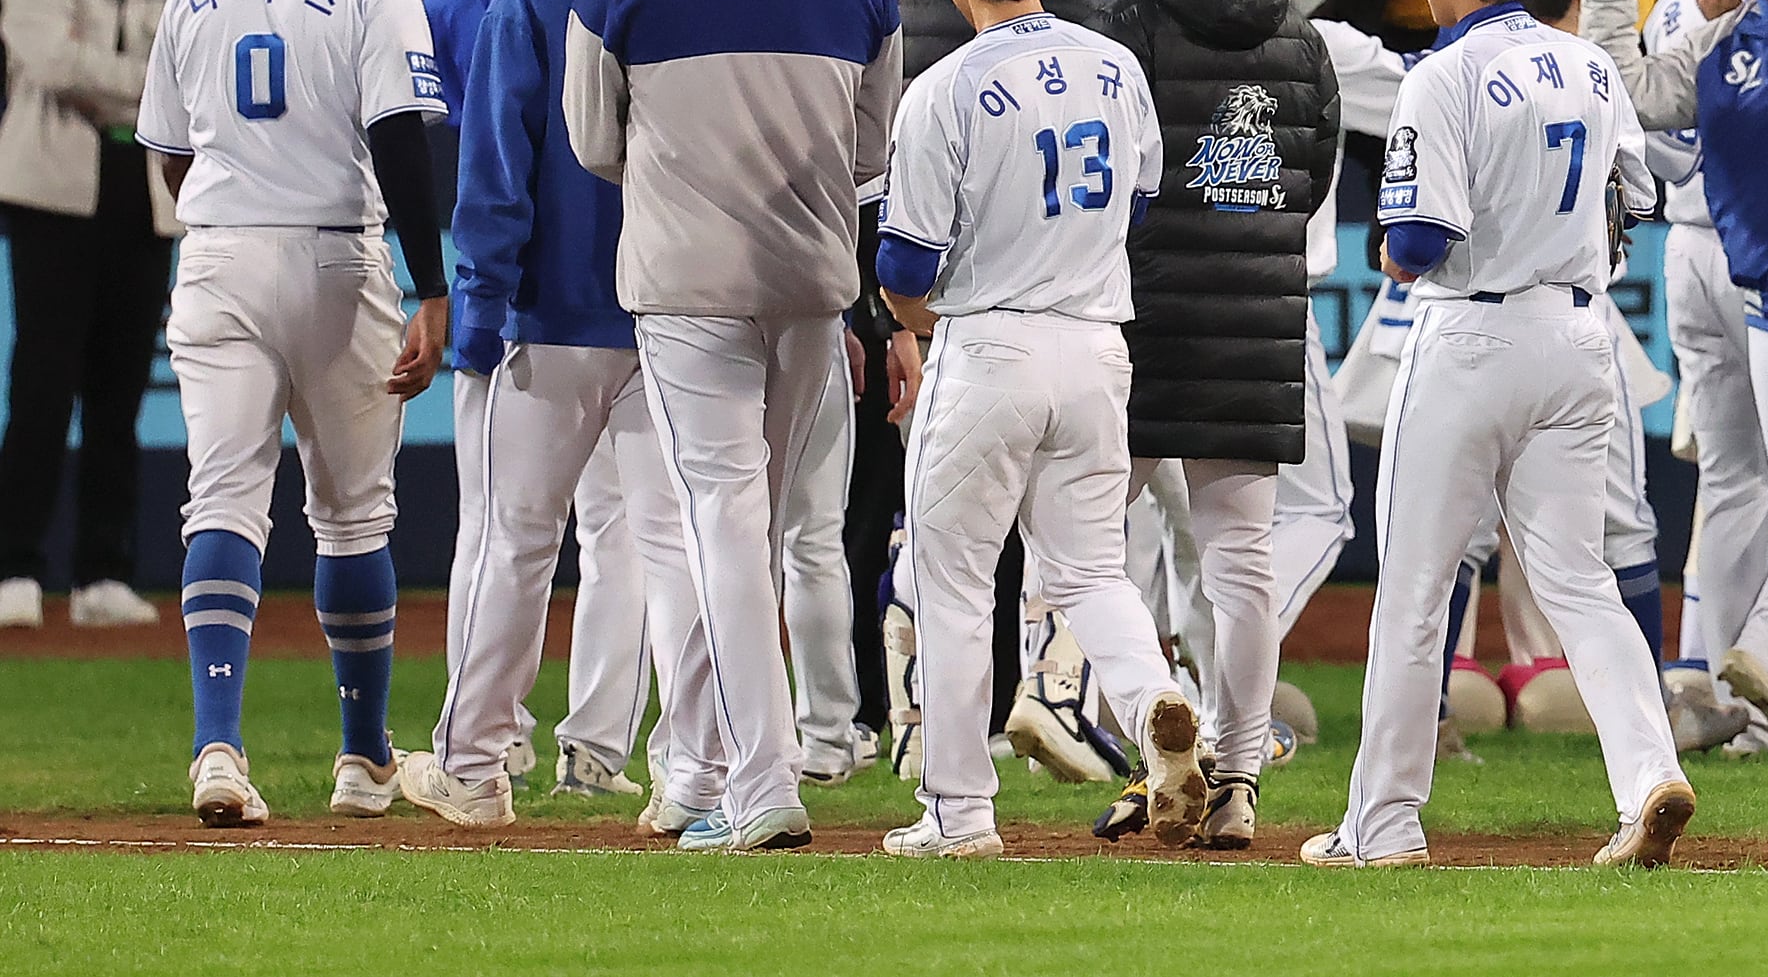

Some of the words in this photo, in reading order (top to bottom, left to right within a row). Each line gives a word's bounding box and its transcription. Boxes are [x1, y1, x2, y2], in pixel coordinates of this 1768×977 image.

[235, 33, 287, 120] 0
[979, 56, 1124, 118] 이성규
[1487, 51, 1610, 109] 이재현
[1724, 50, 1764, 95] SL
[1033, 118, 1115, 220] 13
[1186, 135, 1267, 167] NOW
[1256, 143, 1276, 156] OR
[1186, 156, 1282, 189] NEVER
[1542, 119, 1588, 216] 7
[1203, 186, 1269, 206] POSTSEASON
[1269, 184, 1288, 211] SL
